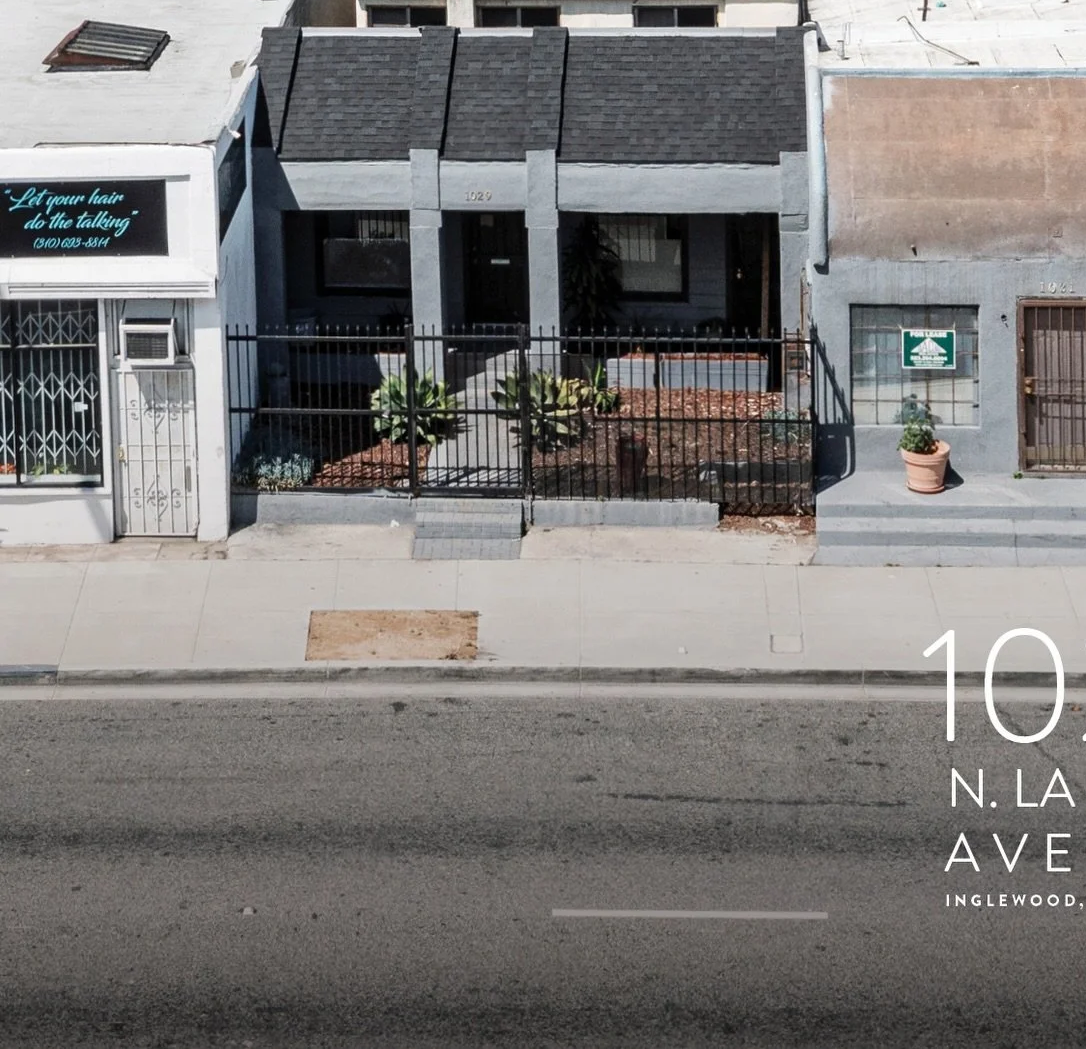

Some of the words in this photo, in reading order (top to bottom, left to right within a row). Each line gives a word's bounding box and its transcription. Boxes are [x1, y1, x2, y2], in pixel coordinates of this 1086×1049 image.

[46, 194, 85, 215] your
[88, 187, 124, 205] hair
[464, 190, 492, 202] 1029
[24, 212, 46, 230] do
[48, 211, 73, 229] the
